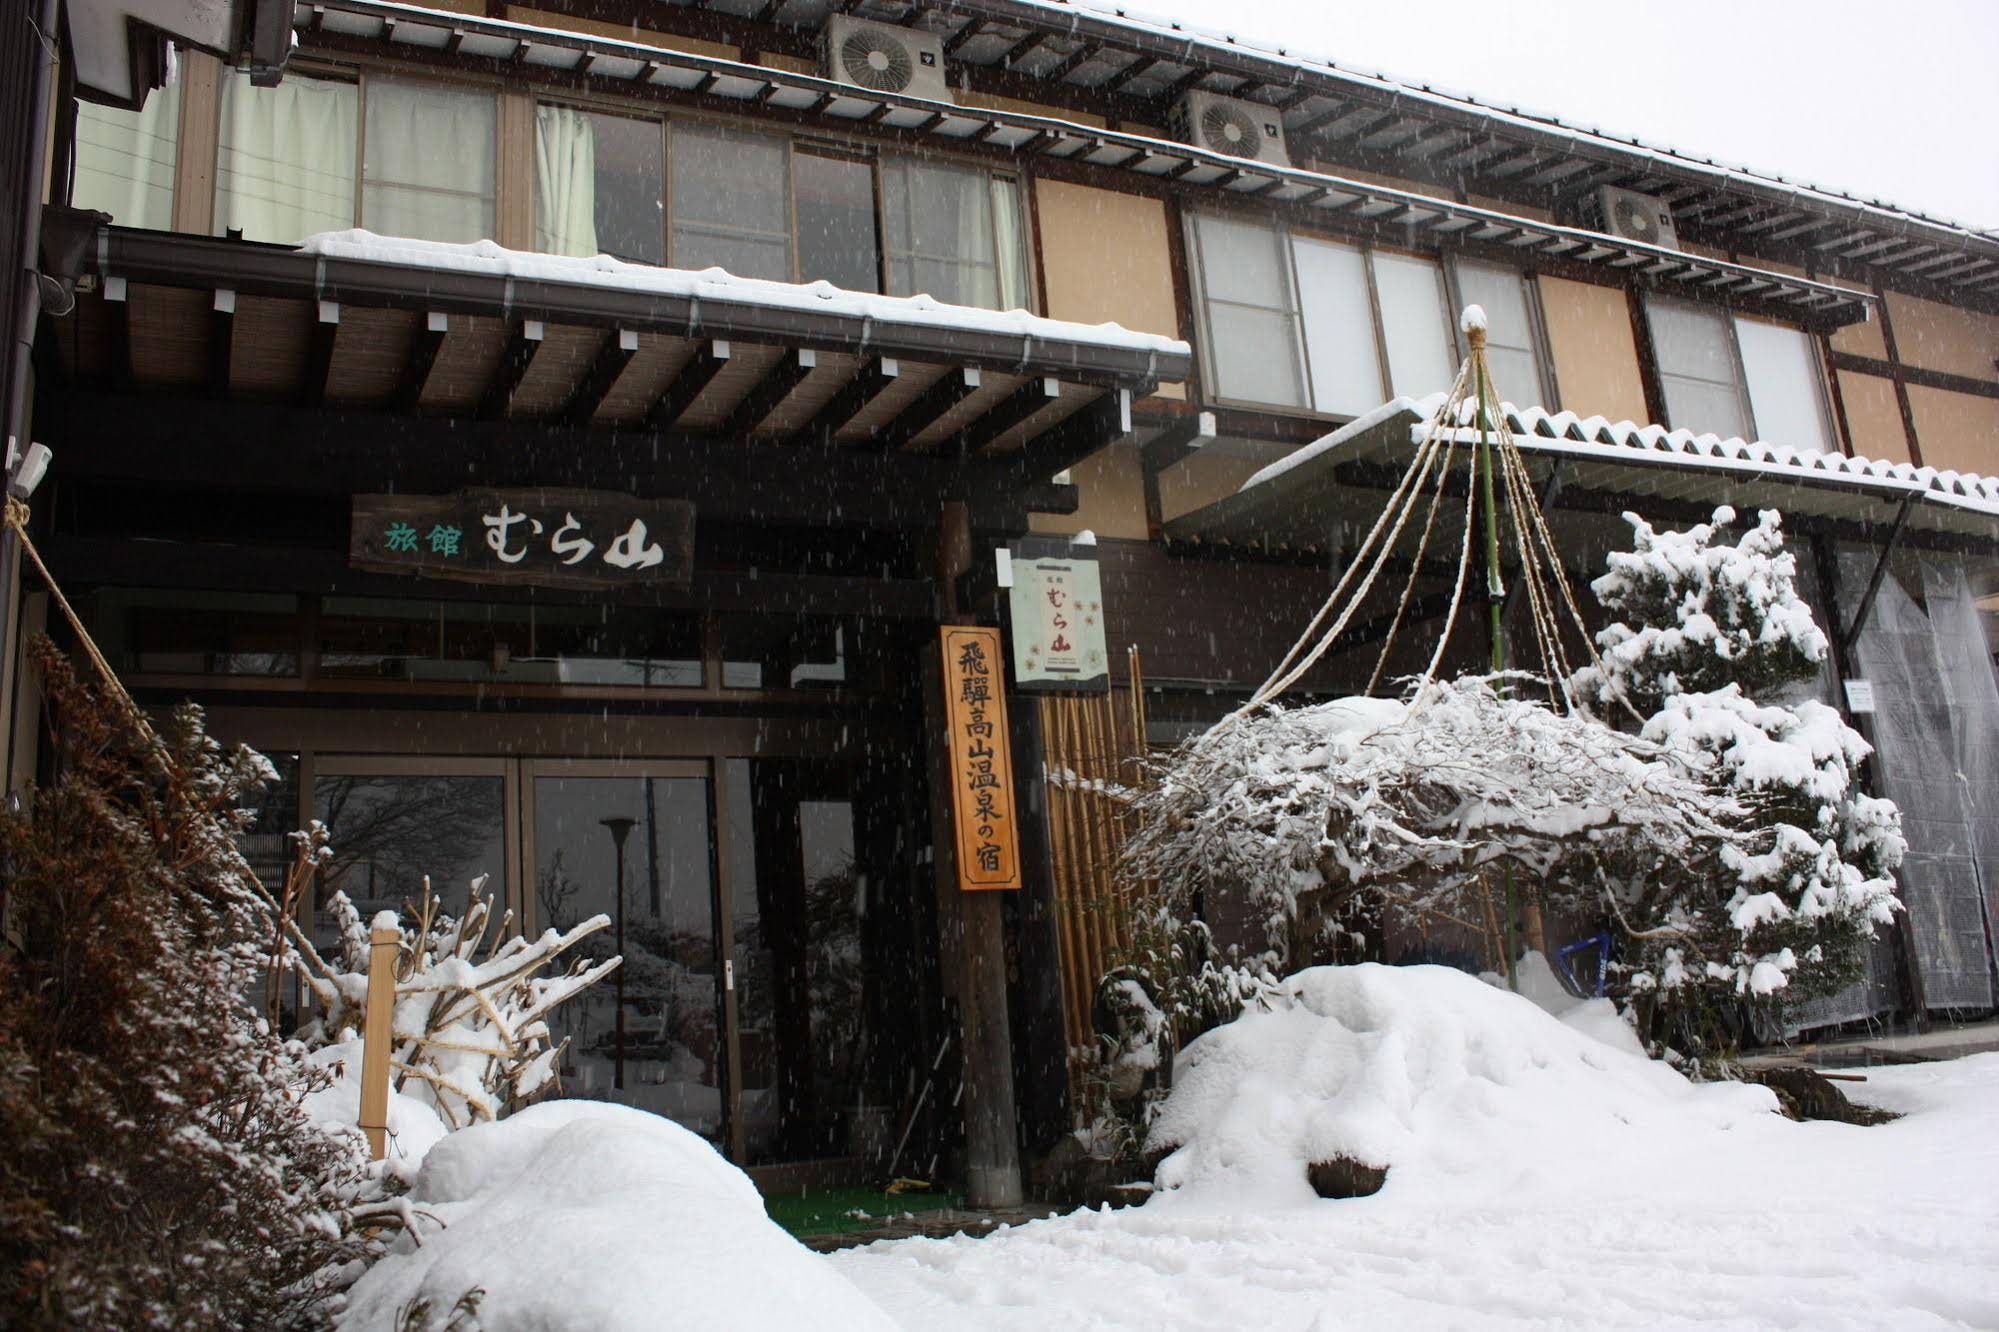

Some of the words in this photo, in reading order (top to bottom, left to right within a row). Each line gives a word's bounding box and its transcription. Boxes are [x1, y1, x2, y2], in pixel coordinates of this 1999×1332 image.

[384, 522, 463, 558] 旅館
[481, 503, 664, 571] むら山
[1046, 587, 1071, 652] むら山
